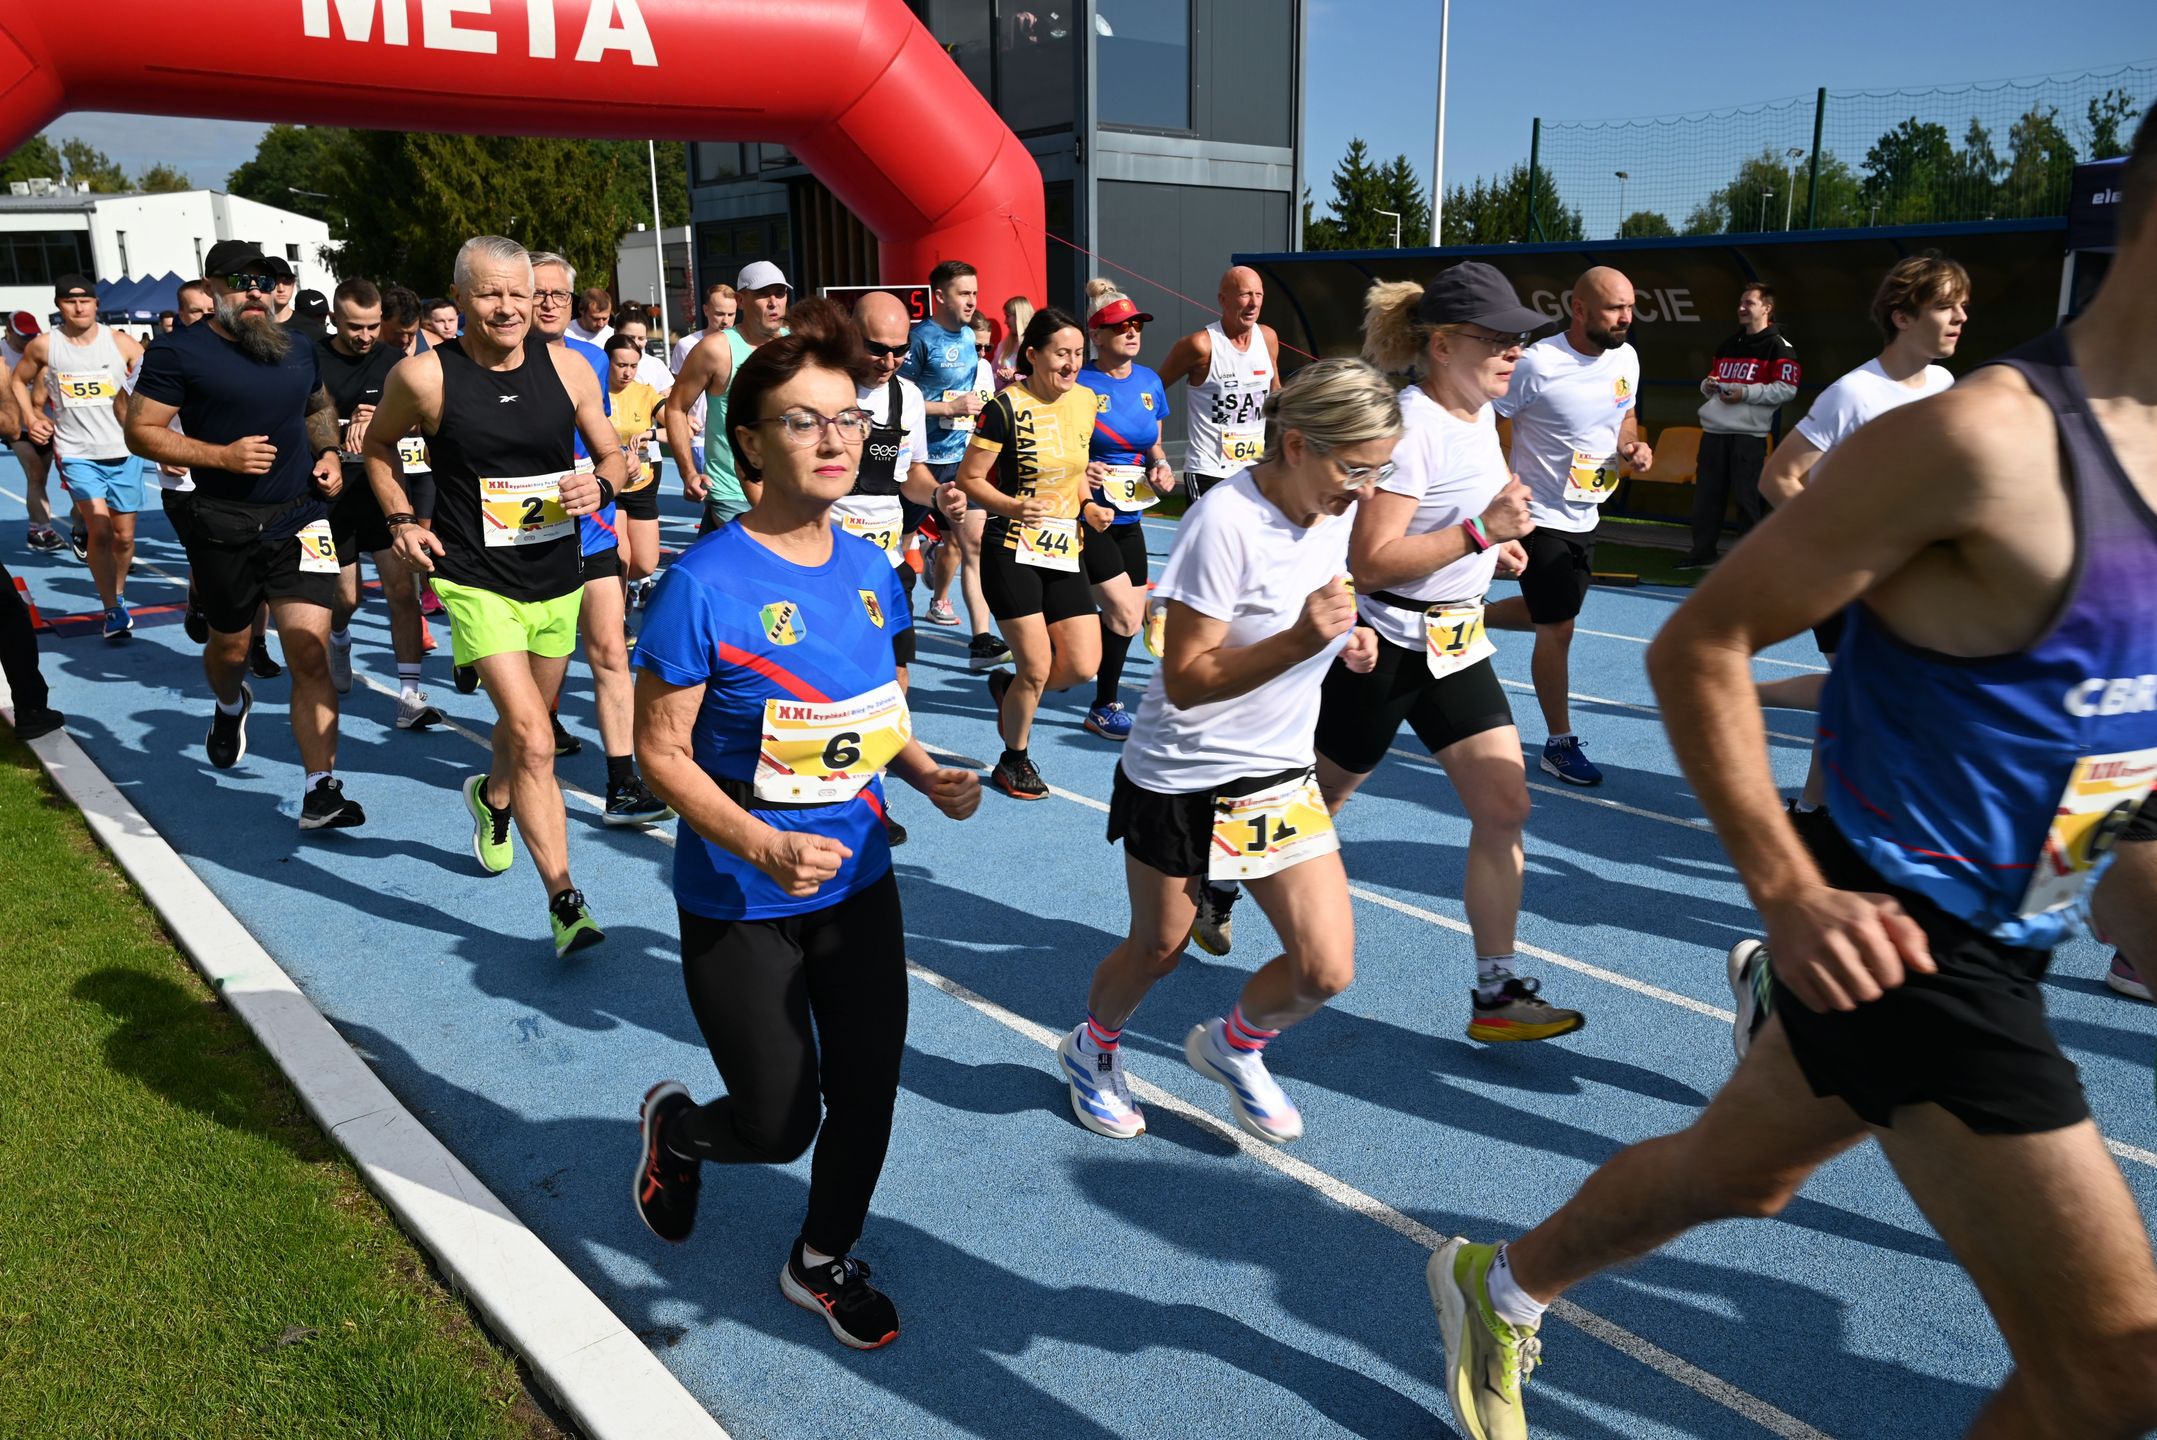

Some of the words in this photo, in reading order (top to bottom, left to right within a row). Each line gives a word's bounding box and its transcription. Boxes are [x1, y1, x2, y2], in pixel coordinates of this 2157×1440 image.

[911, 291, 923, 317] 5
[73, 382, 101, 396] 55
[401, 449, 424, 463] 51
[1234, 441, 1256, 458] 64
[488, 481, 509, 489] XXI
[1592, 467, 1605, 488] 3
[1124, 480, 1136, 498] 9
[522, 497, 544, 524] 2
[318, 536, 337, 556] 5
[1036, 530, 1069, 554] 44
[770, 606, 792, 639] LECH
[778, 705, 812, 720] XXI
[822, 731, 861, 769] 6
